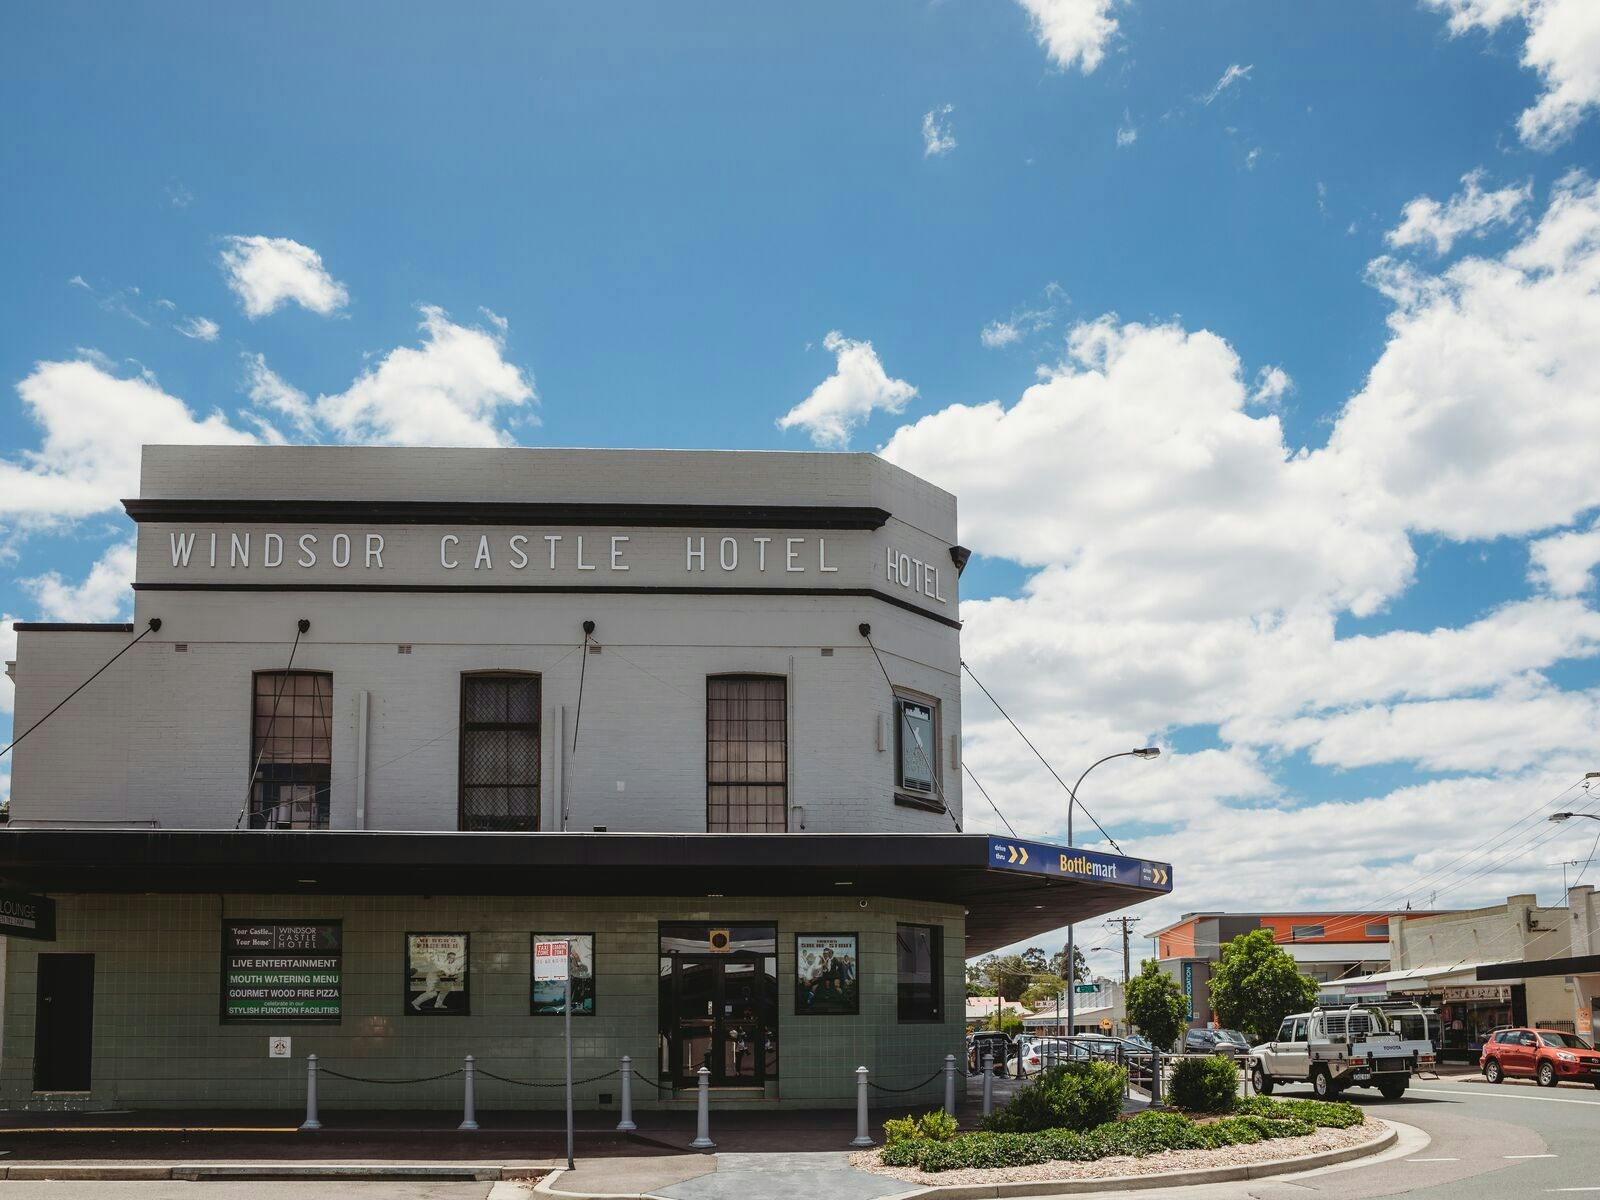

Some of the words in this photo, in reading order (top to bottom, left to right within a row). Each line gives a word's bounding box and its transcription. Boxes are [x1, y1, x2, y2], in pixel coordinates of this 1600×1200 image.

[170, 532, 385, 568] WINDSOR
[440, 535, 631, 570] CASTLE
[686, 536, 839, 572] HOTEL
[886, 546, 947, 604] HOTEL
[994, 844, 1006, 852] drive
[1060, 854, 1117, 879] Bottlemart
[236, 938, 250, 946] Your
[278, 941, 317, 949] HOTEL
[232, 959, 253, 968] LIVE
[255, 959, 337, 968] ENTERTAINMENT
[230, 975, 262, 984] MOUTH
[264, 975, 311, 984] WATERING
[312, 975, 339, 984] MENU
[229, 989, 269, 998] GOURMET
[270, 989, 296, 998] WOOD
[297, 989, 315, 998] FIRE
[316, 989, 339, 998] PIZZA
